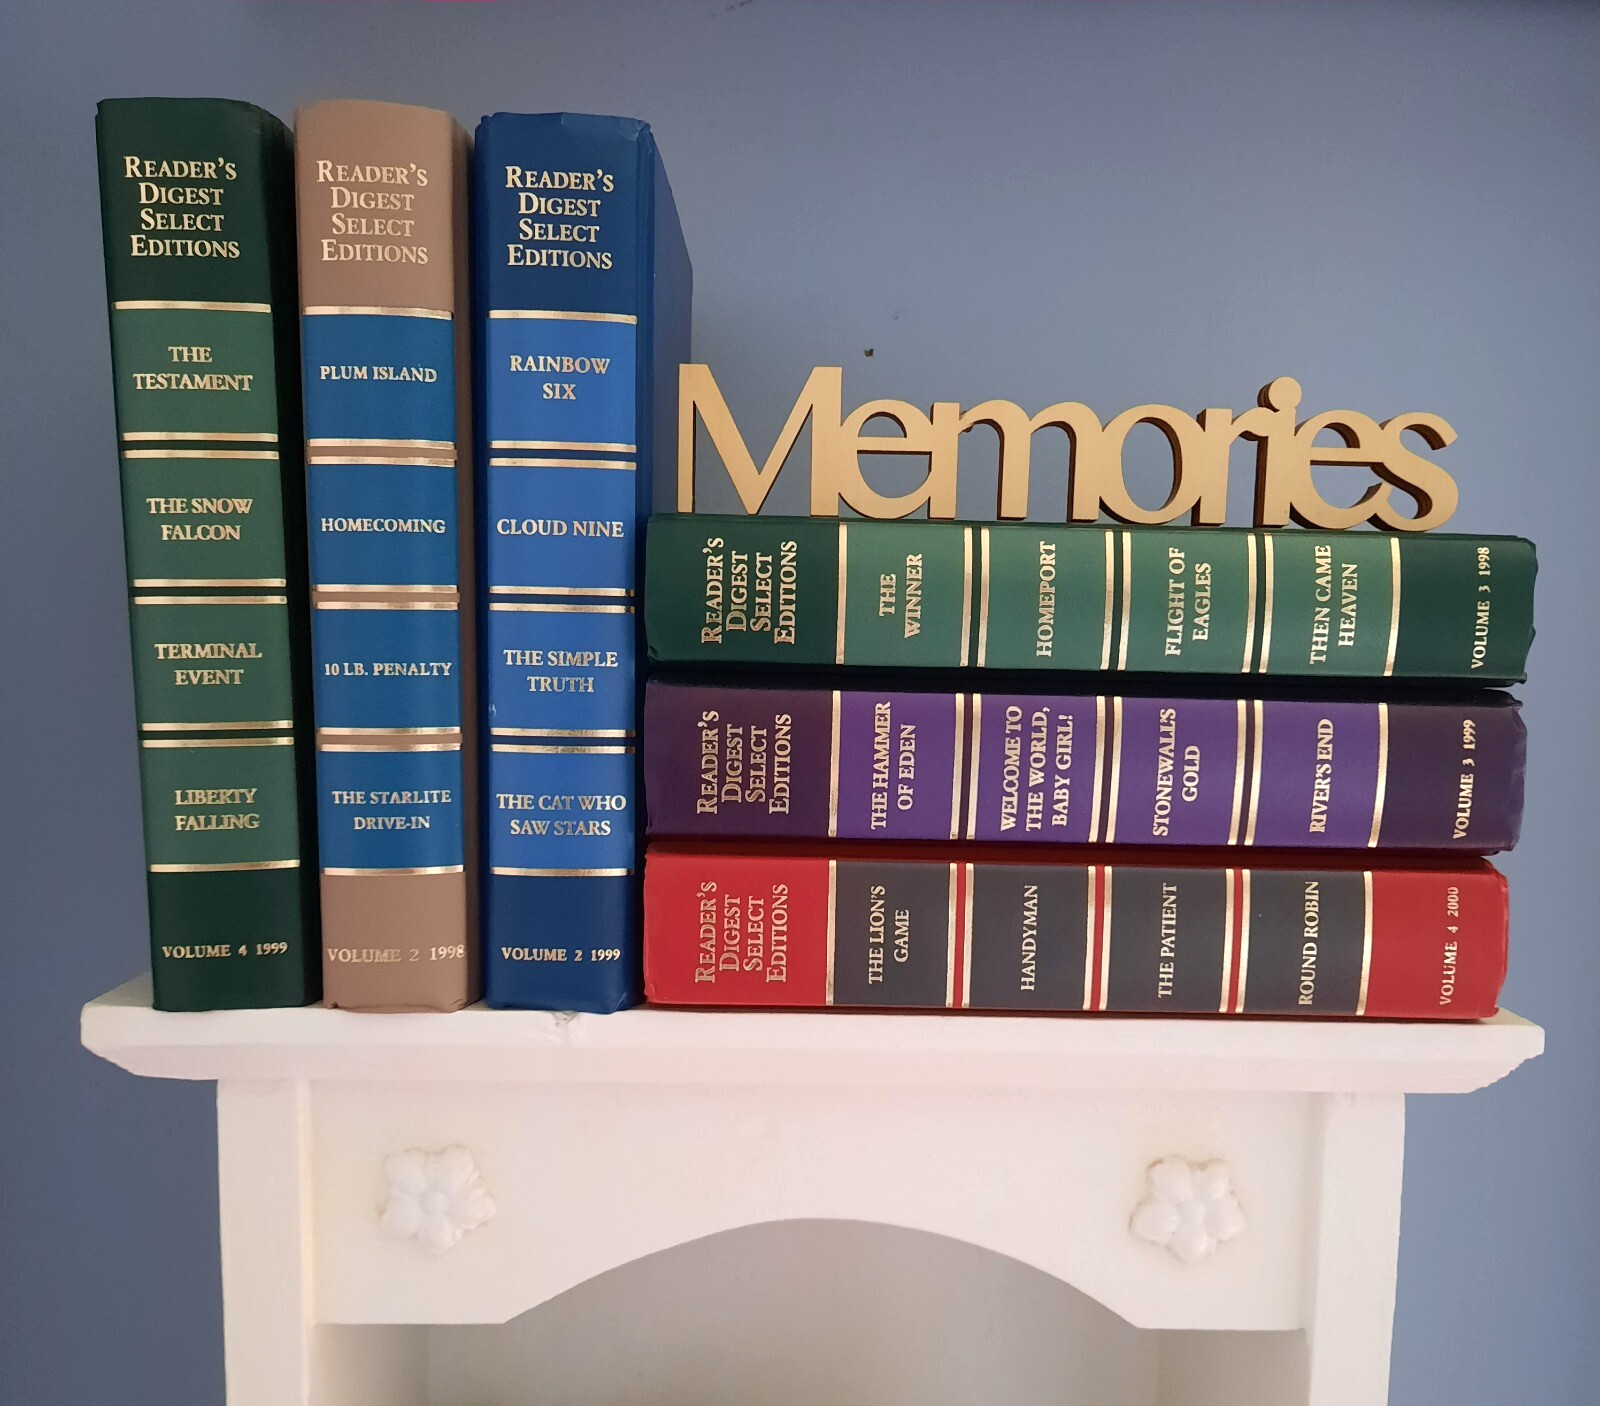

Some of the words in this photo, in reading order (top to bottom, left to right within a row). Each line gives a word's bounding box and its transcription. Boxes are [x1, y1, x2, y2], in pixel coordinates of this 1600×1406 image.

[124, 156, 236, 183] READER'S
[317, 160, 428, 186] READER'S
[505, 166, 614, 195] READER'S
[139, 182, 223, 205] DIGEST
[330, 187, 414, 210] DIGEST
[518, 192, 601, 219] DIGEST
[141, 208, 224, 231] SELECT
[332, 213, 414, 236] SELECT
[517, 219, 599, 245] SELECT
[131, 235, 240, 258] EDITIONS
[321, 239, 428, 264] EDITIONS
[507, 244, 612, 269] EDITIONS
[168, 346, 212, 362] THE
[510, 355, 610, 374] RAINBOW
[133, 373, 253, 391] TESTAMENT
[320, 366, 367, 379] PLUM
[373, 365, 437, 382] ISLAND
[543, 383, 576, 399] SIX
[677, 364, 1459, 534] Memories
[146, 498, 194, 513] THE
[191, 498, 253, 513] SNOW
[161, 525, 240, 540] FALCON
[321, 518, 445, 533] HOMECOMING
[497, 519, 567, 535] CLOUD
[573, 521, 624, 537] NINE
[1169, 548, 1185, 574] OF
[1315, 545, 1331, 601] CAME
[1477, 547, 1490, 575] 1998
[701, 538, 724, 643] READER'S
[726, 551, 751, 631] DIGEST
[750, 552, 772, 631] SELECT
[774, 541, 797, 644] EDITIONS
[879, 574, 896, 616] THE
[904, 554, 922, 638] WINNER
[1036, 541, 1055, 656] HOMEPORT
[1193, 563, 1211, 640] EAGLES
[1338, 564, 1357, 646] HEAVEN
[1165, 579, 1184, 655] FLIGHT
[1471, 601, 1489, 668] VOLUME
[154, 643, 262, 659] TERMINAL
[1310, 608, 1330, 664] THEN
[174, 669, 244, 685] EVENT
[325, 663, 339, 675] 10
[343, 663, 368, 675] LB.
[373, 662, 452, 675] PENALTY
[503, 650, 543, 665] THE
[548, 651, 618, 667] SIMPLE
[527, 676, 594, 692] TRUTH
[1006, 706, 1022, 741] TO
[1056, 715, 1073, 769] GIRL!
[1317, 719, 1333, 760] END
[697, 711, 719, 814] READER'S
[873, 702, 890, 786] HAMMER
[899, 724, 915, 779] EDEN
[1029, 707, 1050, 787] WORLD,
[721, 724, 746, 803] DIGEST
[745, 726, 770, 805] SELECT
[769, 714, 791, 814] EDITIONS
[1153, 709, 1176, 836] STONEWALL'S
[1182, 746, 1200, 801] GOLD
[1453, 774, 1473, 838] VOLUME
[1463, 720, 1475, 749] 1999
[175, 788, 257, 805] LIBERTY
[332, 791, 366, 804] THE
[370, 790, 451, 804] STARLITE
[496, 794, 534, 809] THE
[538, 795, 574, 810] CAT
[578, 795, 626, 810] WHO
[898, 784, 913, 810] OF
[1001, 741, 1020, 831] WELCOME
[1052, 775, 1070, 826] BABY
[1310, 764, 1331, 832] RIVER'S
[175, 814, 259, 830] FALLING
[354, 816, 430, 829] DRIVE-IN
[871, 785, 888, 830] THE
[1026, 792, 1043, 831] THE
[511, 820, 550, 834] SAW
[554, 821, 611, 835] STARS
[870, 886, 885, 943] LION'S
[1161, 883, 1176, 957] PATIENT
[1304, 882, 1319, 944] ROBIN
[1448, 887, 1458, 917] 2000
[162, 945, 231, 958] VOLUME
[239, 945, 247, 956] 4
[257, 942, 287, 955] 1999
[695, 882, 717, 983] READER'S
[719, 894, 740, 971] DIGEST
[743, 896, 764, 971] SELECT
[763, 884, 788, 982] EDITIONS
[894, 910, 909, 962] GAME
[1021, 886, 1037, 990] HANDYMAN
[328, 949, 401, 962] VOLUME
[409, 949, 419, 961] 2
[431, 943, 467, 962] 1998
[502, 947, 567, 961] VOLUME
[575, 950, 582, 961] 2
[592, 949, 620, 961] 1999
[869, 948, 883, 984] THE
[1158, 962, 1174, 998] THE
[1299, 944, 1317, 1004] ROUND
[1440, 942, 1457, 1004] VOLUME
